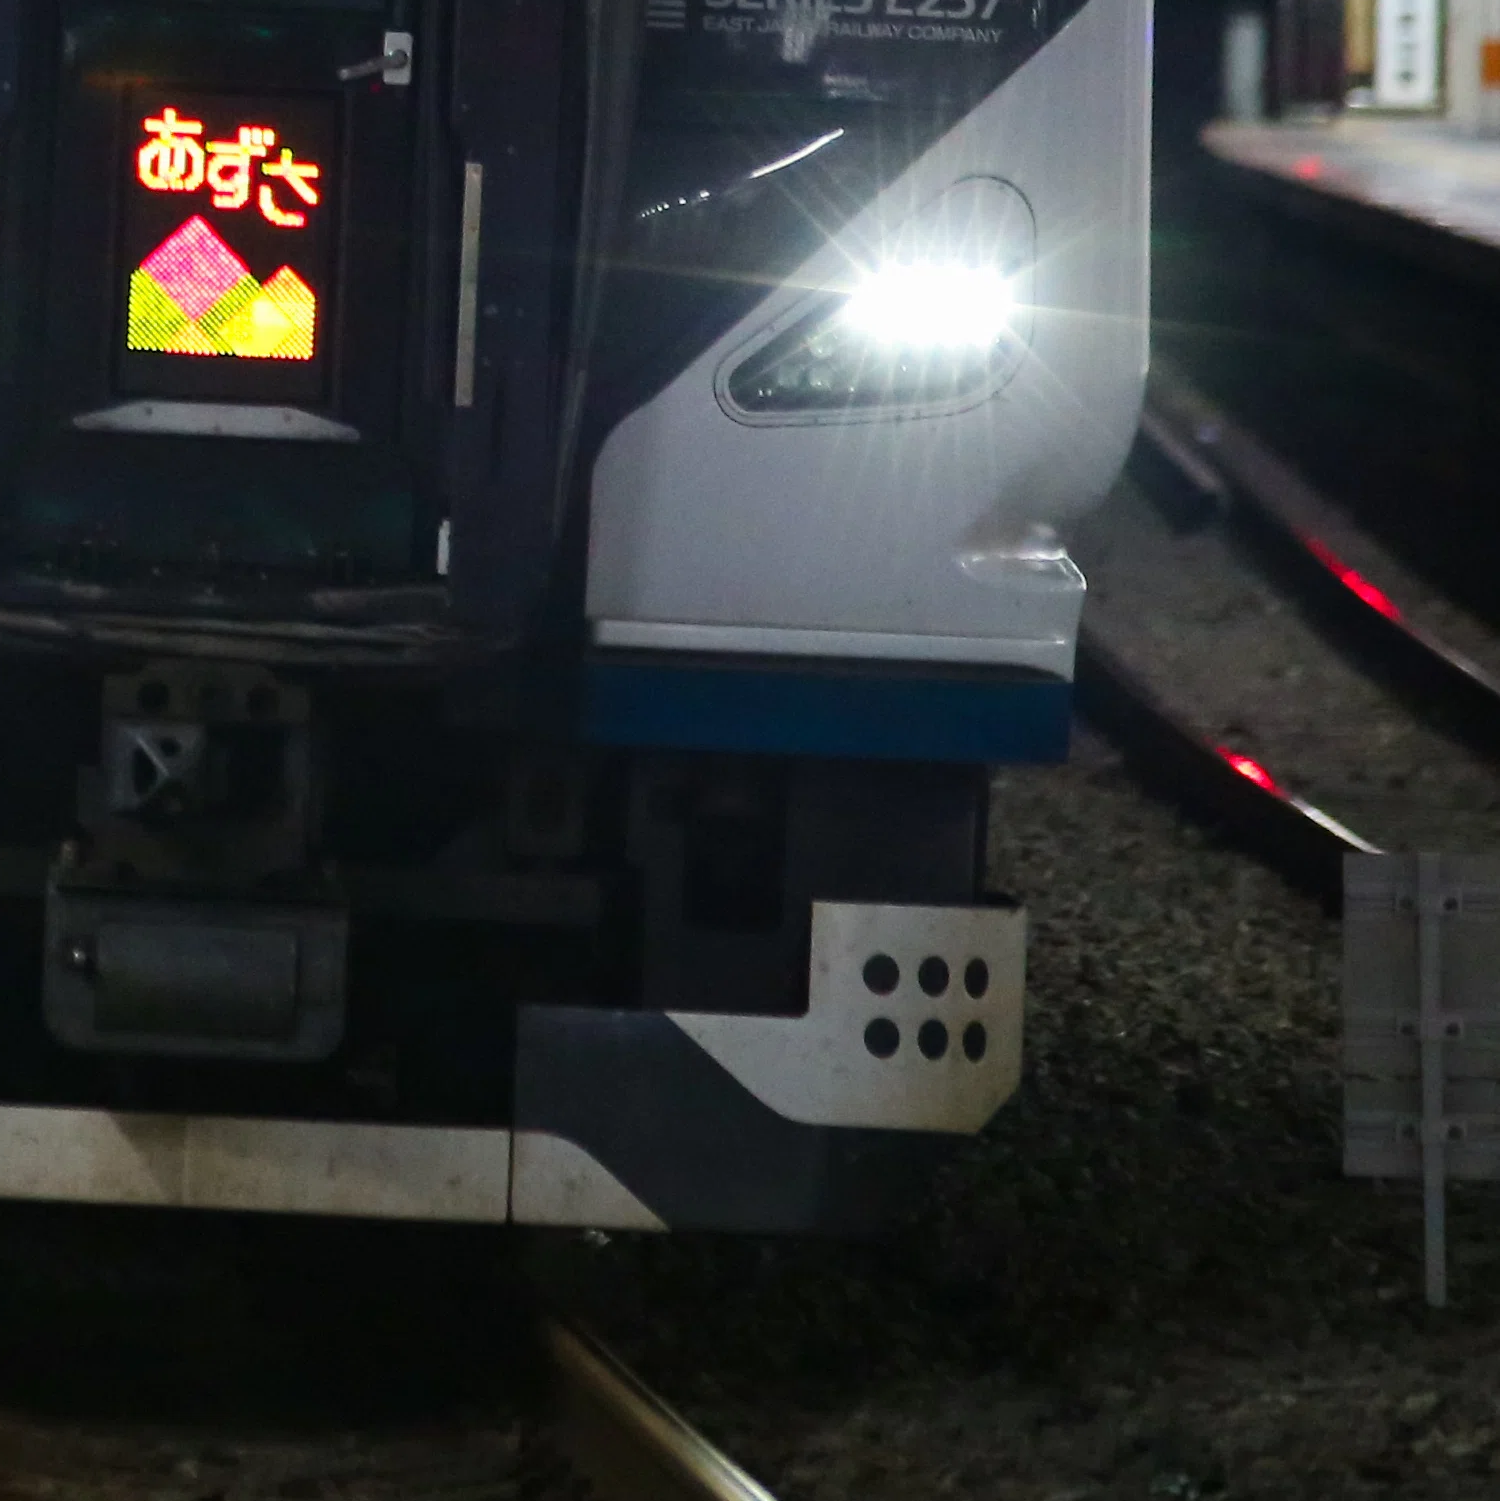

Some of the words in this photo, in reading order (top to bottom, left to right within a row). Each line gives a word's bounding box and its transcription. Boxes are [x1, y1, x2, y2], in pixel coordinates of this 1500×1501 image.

[702, 15, 754, 32] EAST
[828, 21, 902, 39] RAILWAY
[907, 25, 1004, 44] COMPANY
[138, 106, 321, 228] あずさ
